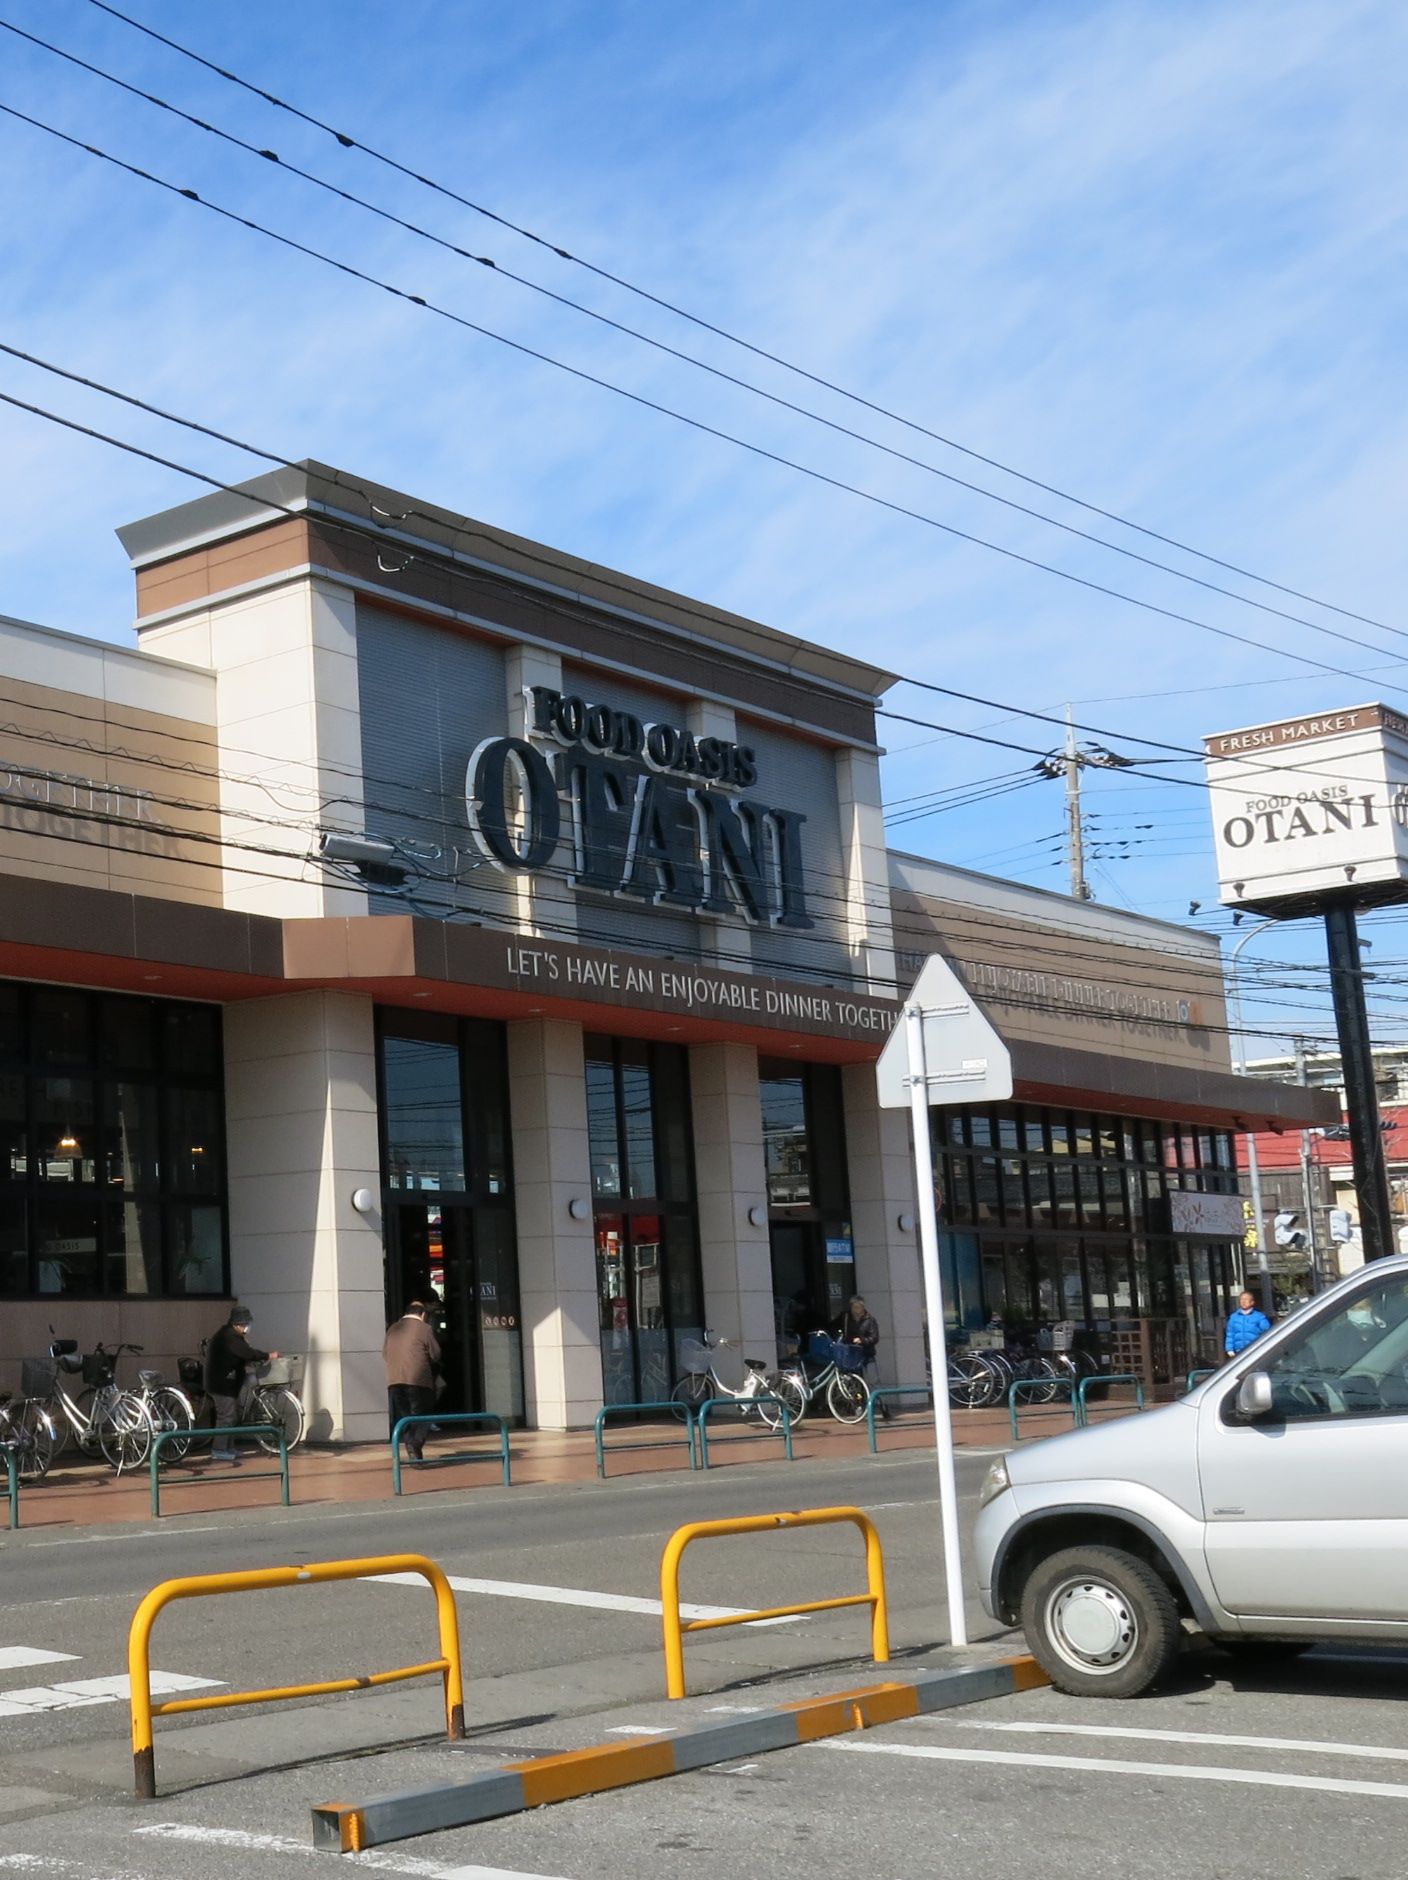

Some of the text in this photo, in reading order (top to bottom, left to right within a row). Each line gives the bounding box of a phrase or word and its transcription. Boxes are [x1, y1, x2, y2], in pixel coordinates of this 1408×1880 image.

[523, 685, 758, 791] FOOD OASIS
[1220, 730, 1274, 752] FRESH
[1282, 713, 1359, 741] MARKET
[466, 736, 815, 929] OTANI
[1223, 794, 1379, 848] OTANI
[1245, 784, 1348, 814] FOOD OASIS
[507, 947, 899, 1033] LET'S HAVE AN ENJOYABLE DINNER TOGETH
